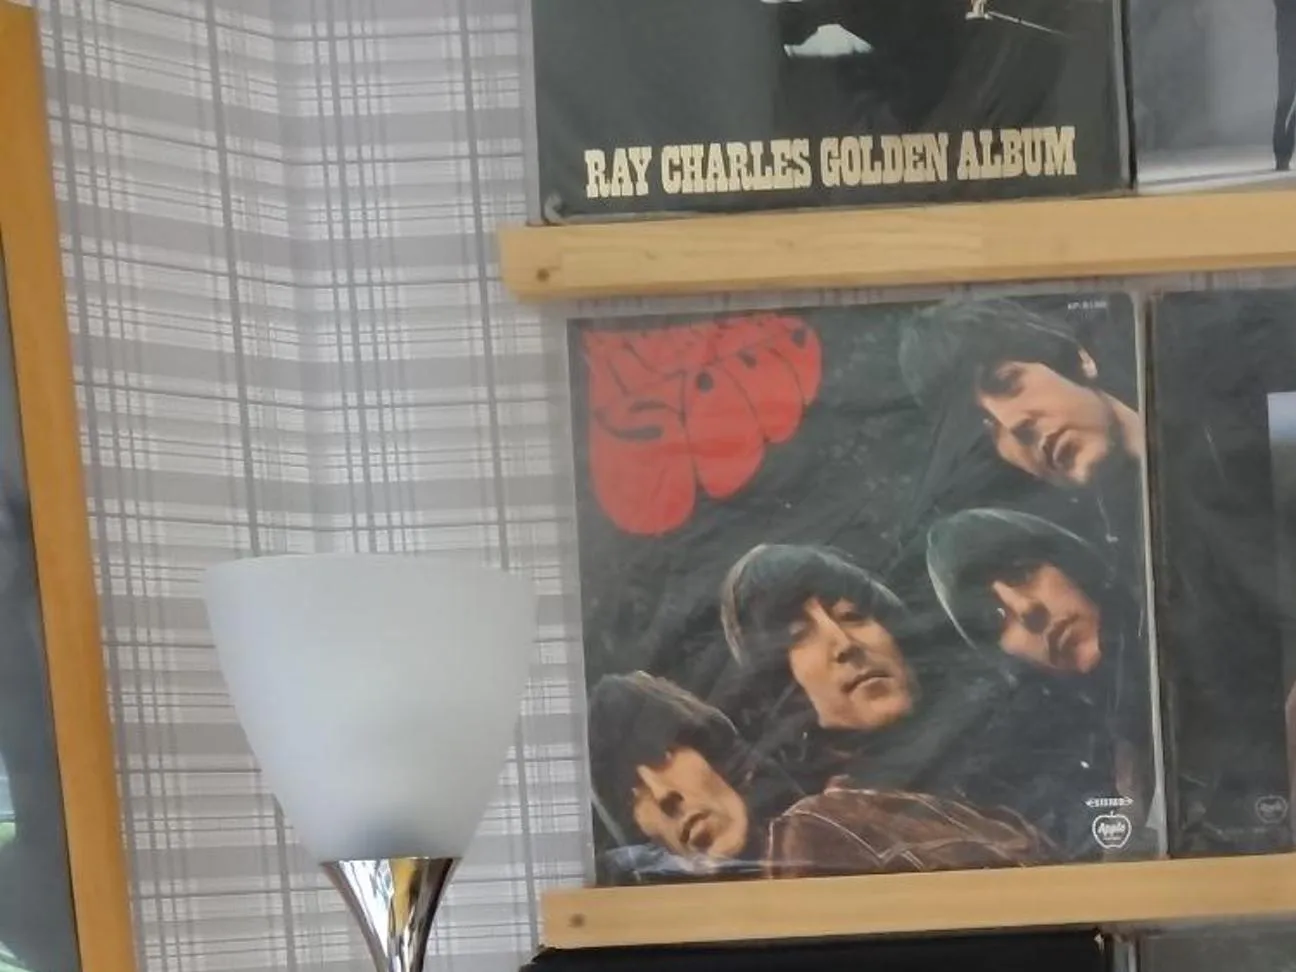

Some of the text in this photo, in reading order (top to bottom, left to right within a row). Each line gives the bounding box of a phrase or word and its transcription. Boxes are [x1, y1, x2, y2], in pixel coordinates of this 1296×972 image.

[585, 126, 1077, 199] RAY CHARLES GOLDEN ALBUM
